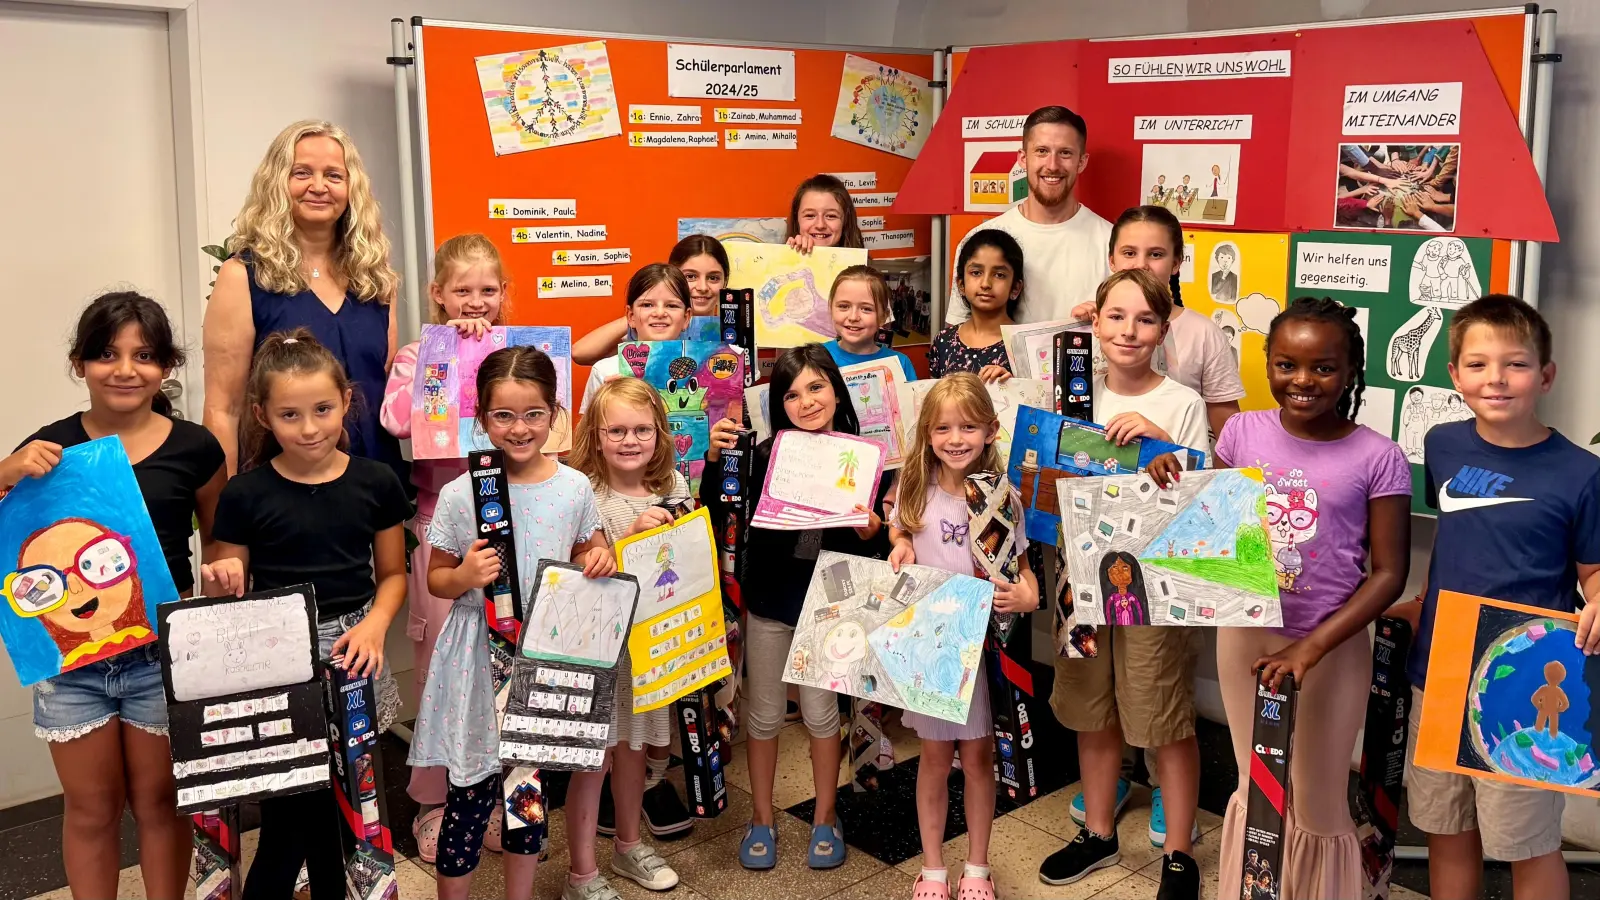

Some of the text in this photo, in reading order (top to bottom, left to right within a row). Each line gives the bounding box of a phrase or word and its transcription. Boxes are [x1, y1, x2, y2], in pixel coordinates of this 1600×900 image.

[675, 59, 782, 76] Schülerparlament
[1113, 59, 1287, 76] SO FÜHLEN WIR UNS WOHL
[705, 83, 758, 97] 2024/25
[1347, 88, 1439, 103] IM UMGANG
[650, 113, 673, 122] Ennio,
[966, 118, 1025, 130] IM SCHULH
[1139, 119, 1243, 130] IM UNTERRICHT
[1345, 113, 1457, 127] MITEINANDER
[745, 133, 768, 141] Amina,
[772, 132, 797, 140] Mihailo
[493, 207, 508, 215] 4a:
[513, 207, 549, 216] Dominik,
[516, 231, 531, 239] 4b:
[535, 230, 573, 239] Valentin,
[557, 254, 570, 262] 4c:
[574, 253, 600, 262] Yasin,
[1303, 252, 1388, 267] Wir helfen uns
[542, 281, 556, 289] 4d:
[560, 280, 591, 289] Melina,
[1300, 273, 1368, 288] gegenseitig.
[1069, 356, 1085, 372] XL
[724, 455, 739, 472] XL
[479, 477, 499, 496] XL
[1447, 464, 1515, 498] NIKE
[481, 520, 509, 533] CLUEDO
[346, 689, 366, 710] XL
[1261, 700, 1281, 720] XL
[683, 707, 701, 753] CLUEDO
[1017, 703, 1034, 749] CLUEDO
[348, 731, 375, 748] CLUEDO
[330, 723, 345, 777] CLUEDO
[1255, 744, 1283, 756] CLUEDO
